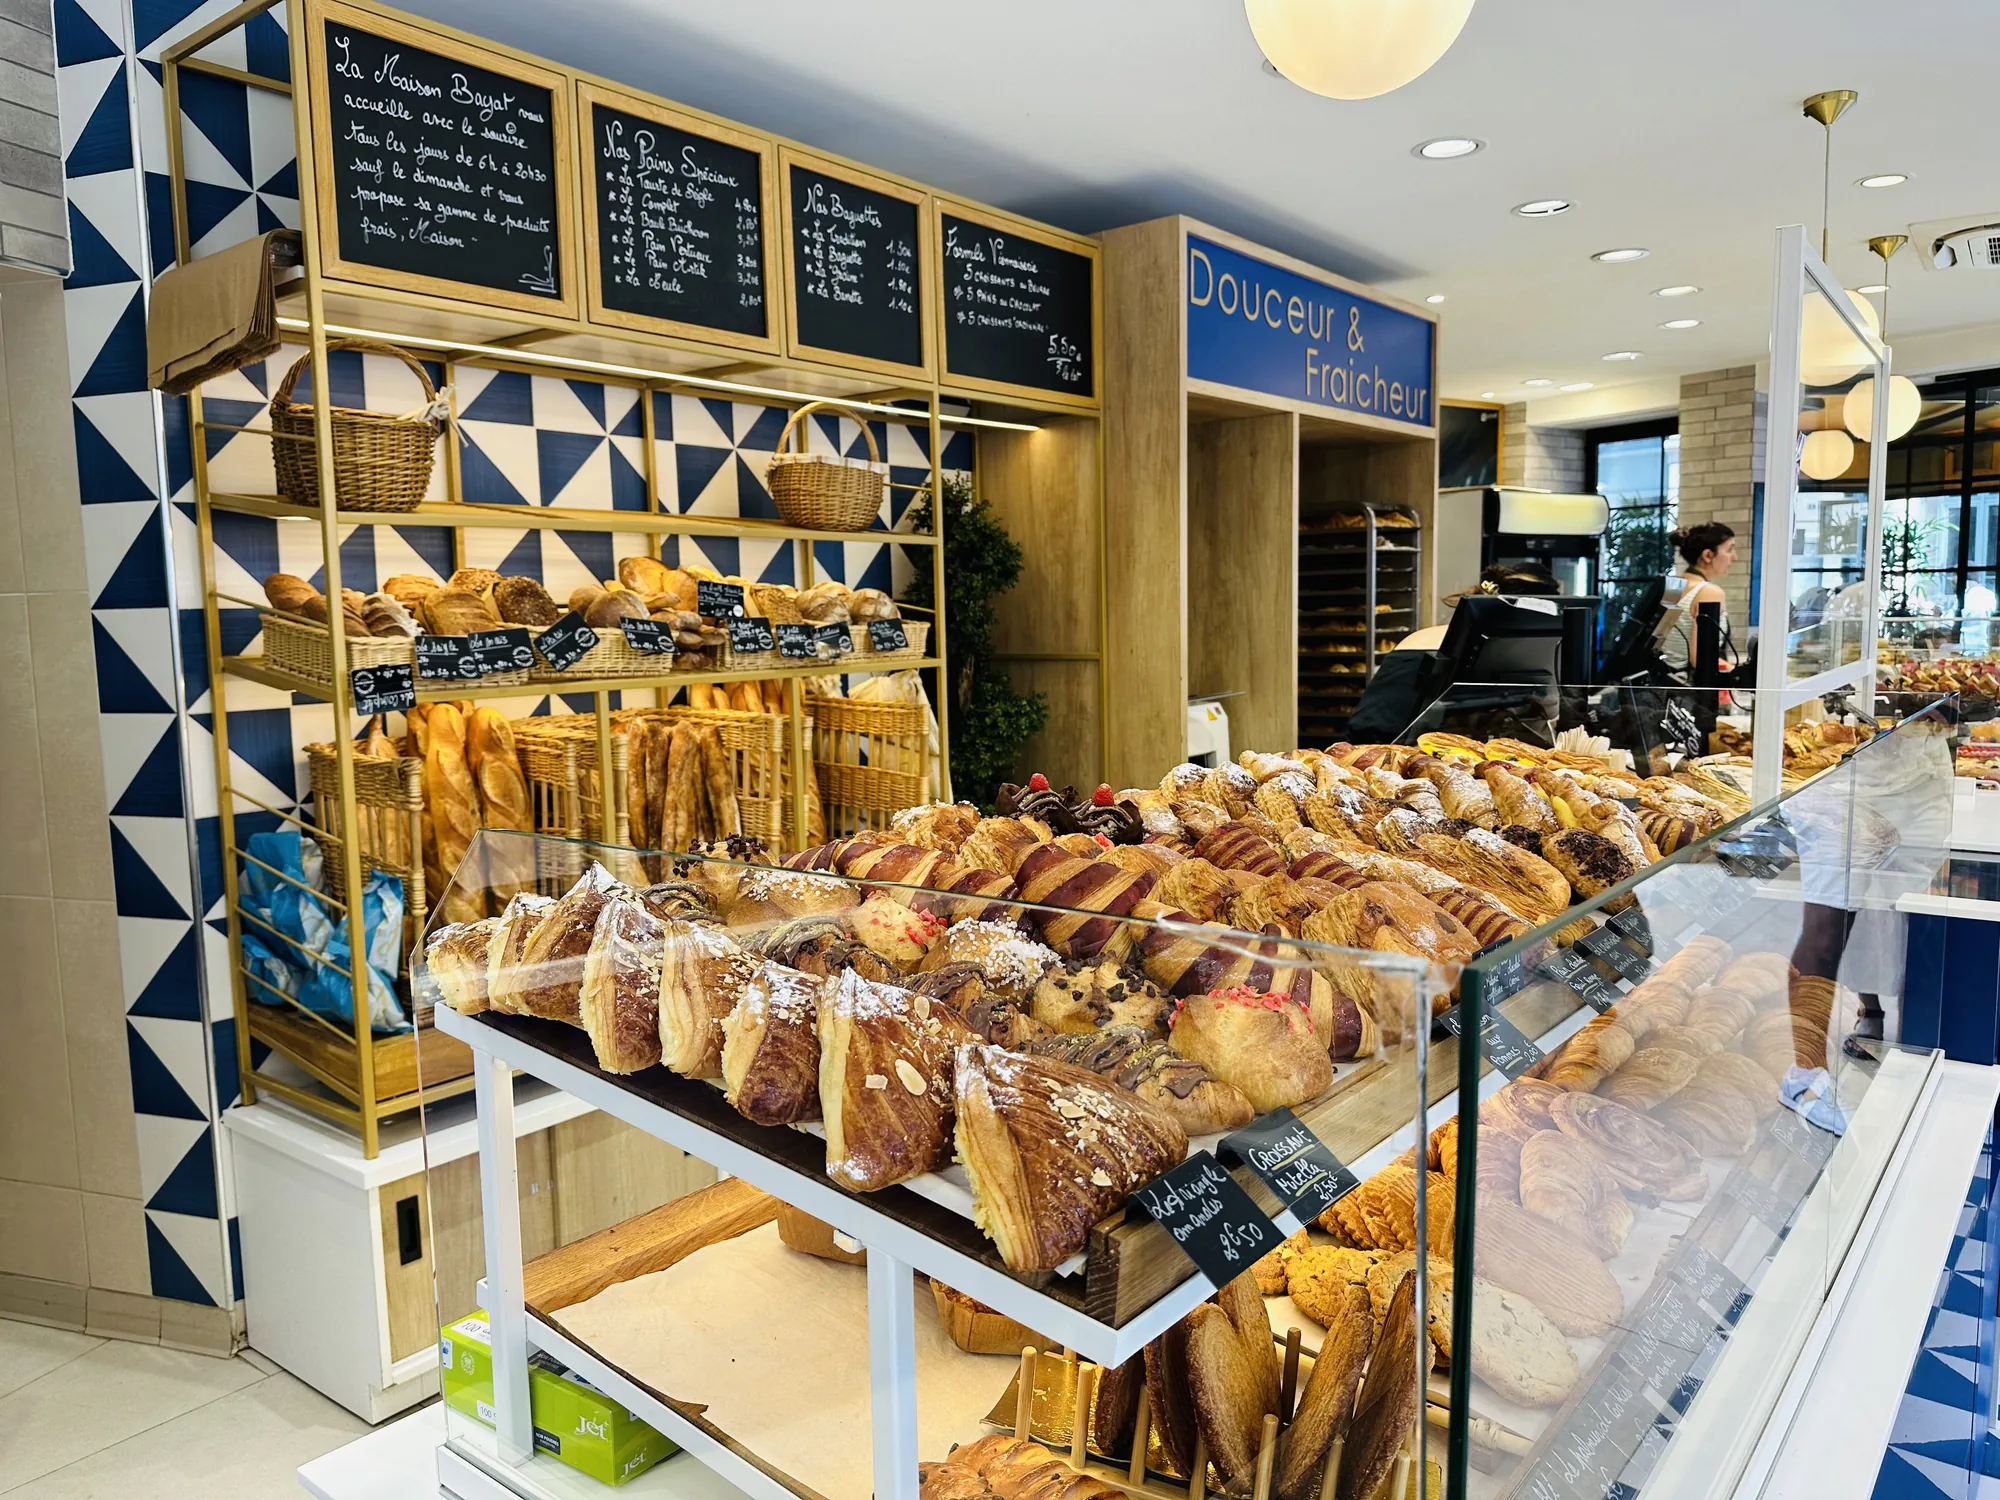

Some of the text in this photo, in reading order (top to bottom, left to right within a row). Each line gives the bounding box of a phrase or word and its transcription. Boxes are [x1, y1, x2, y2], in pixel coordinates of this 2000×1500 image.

[335, 36, 545, 124] La Maison Bayat vous
[344, 93, 529, 149] accueille avec le sourire
[343, 121, 547, 183] tous les jours de 6h à 20h30
[604, 120, 739, 187] Nos Pains Spéciaux
[349, 156, 524, 206] sauf le dimanche et vous
[619, 164, 634, 187] La
[671, 182, 683, 197] de
[350, 185, 550, 235] propose sa gamme de produits
[619, 186, 634, 206] Le
[641, 193, 680, 214] Complet
[803, 183, 882, 229] Nos Baguettes
[619, 205, 635, 225] La
[622, 227, 635, 246] Le
[642, 229, 666, 252] Pain
[812, 219, 825, 242] La
[624, 247, 636, 267] Le
[644, 249, 667, 270] Pain
[813, 241, 824, 260] La
[828, 245, 863, 270] Baguette
[814, 260, 827, 278] La
[625, 267, 641, 287] La
[963, 263, 974, 281] 5
[816, 279, 829, 299] La
[966, 286, 974, 301] 5
[1190, 247, 1365, 353] Douceur &
[967, 310, 976, 325] 5
[1306, 348, 1427, 420] Fraicheur
[1485, 1034, 1503, 1046] aux
[1275, 1158, 1326, 1196] Nutella
[1219, 1222, 1264, 1262] 2€50
[480, 1406, 493, 1418] 100
